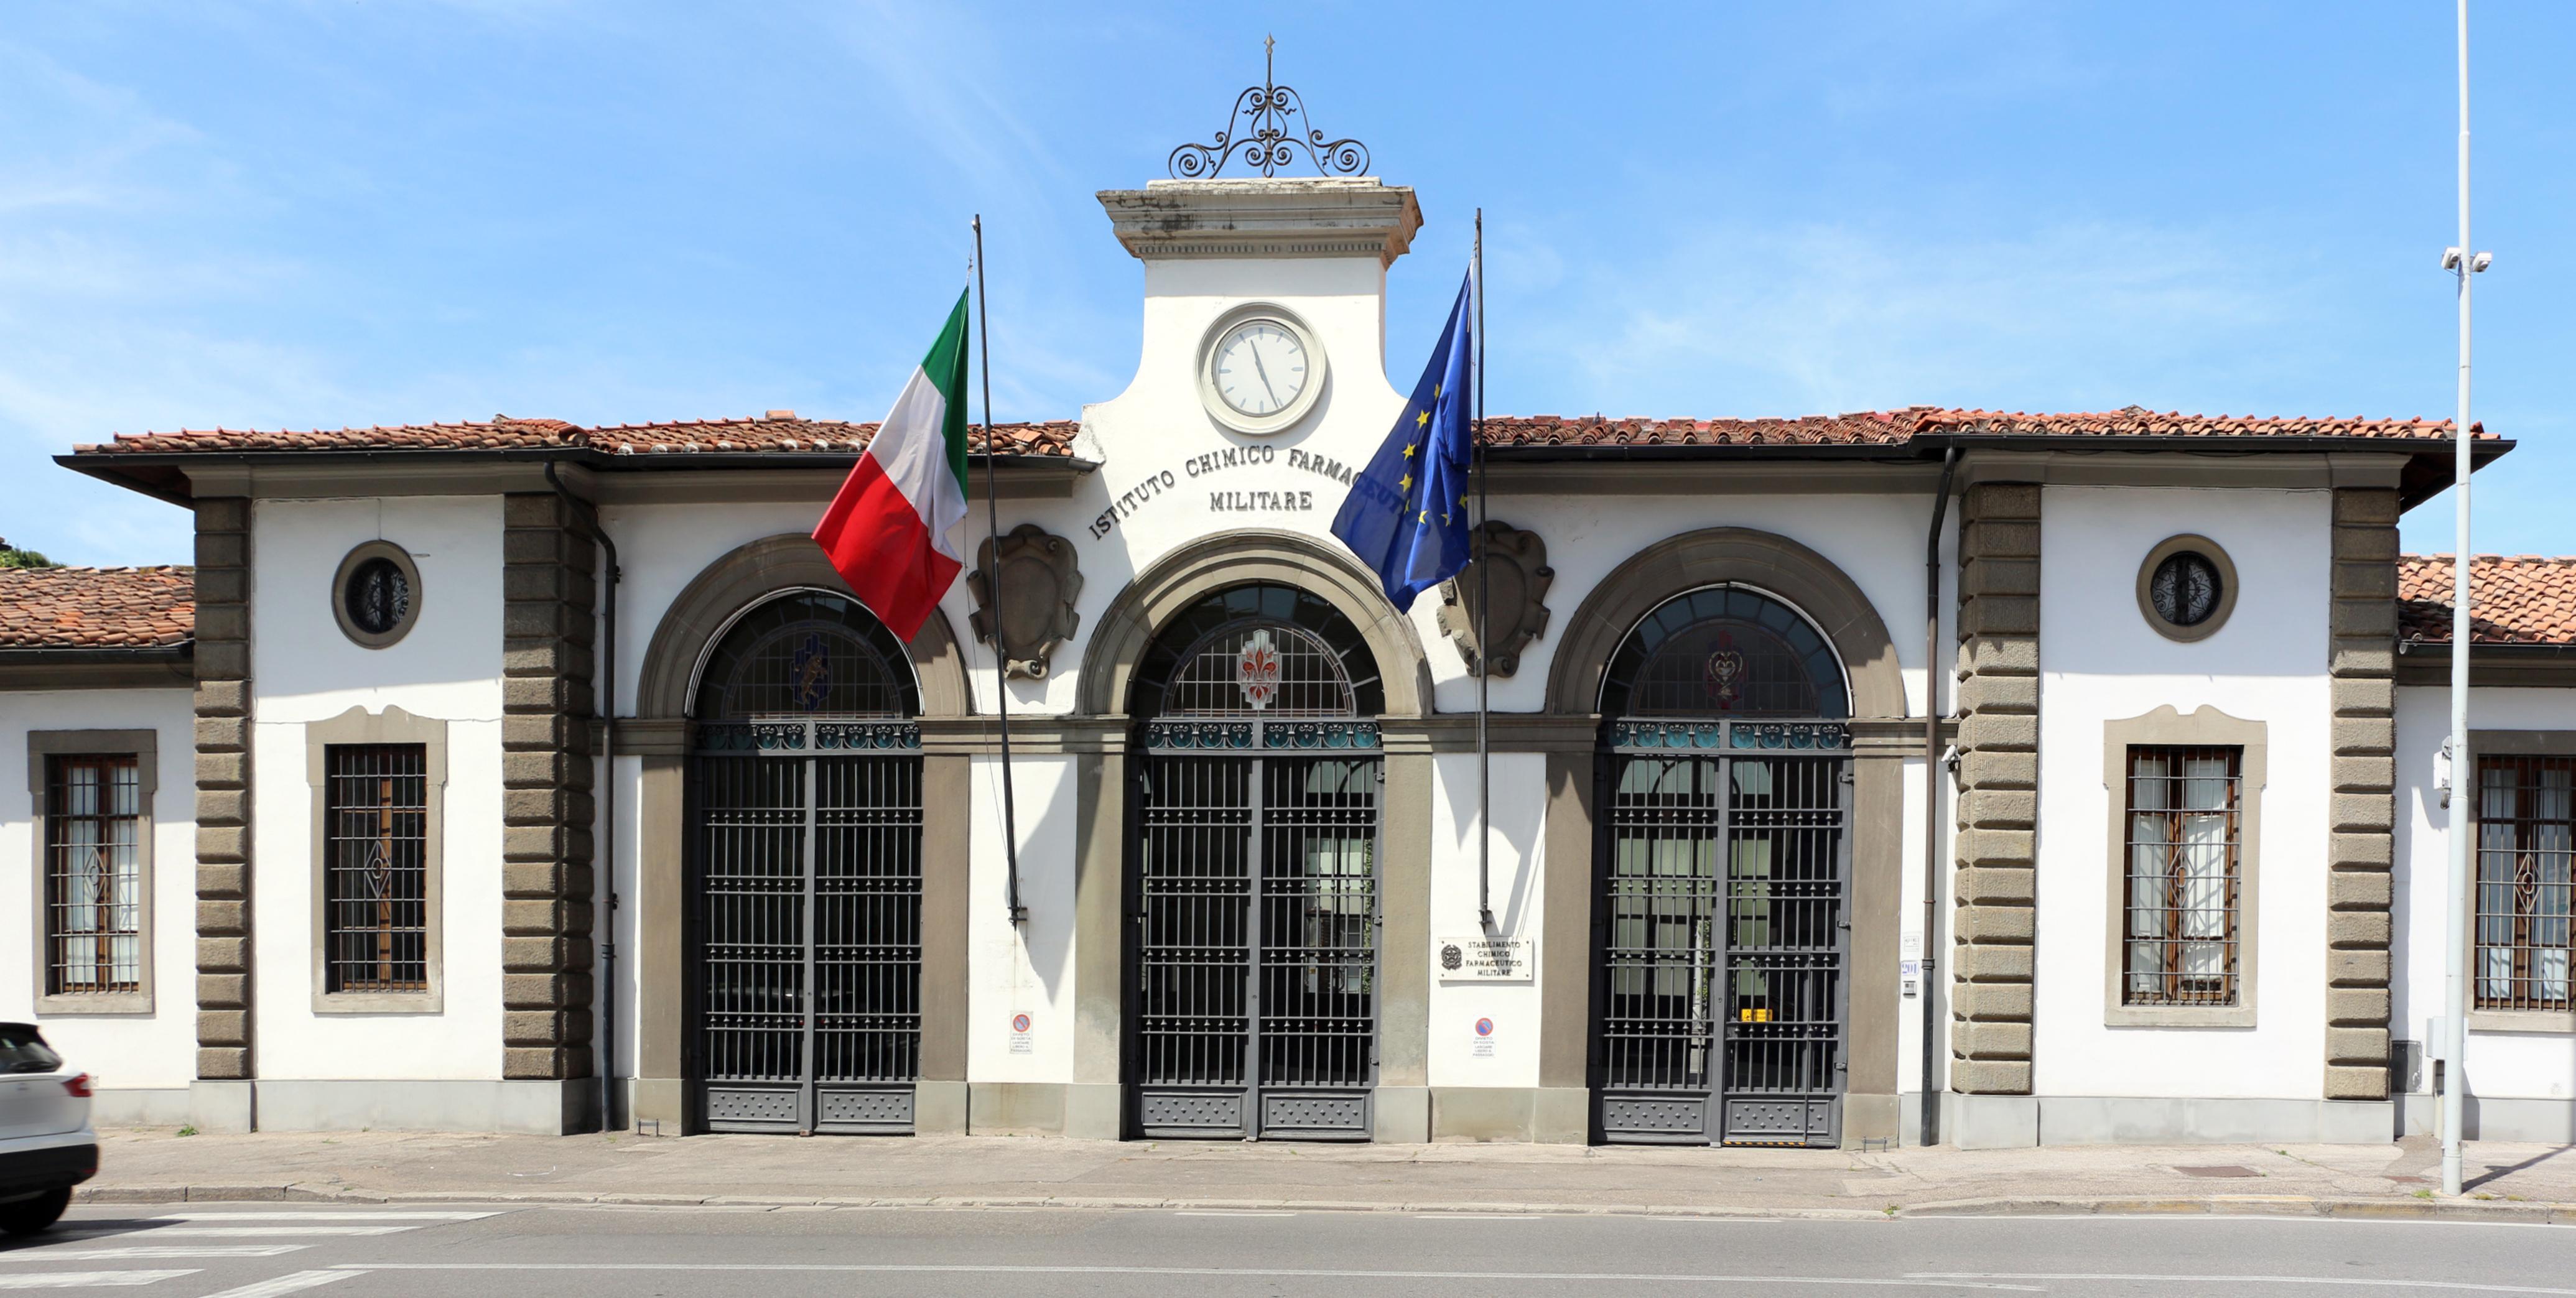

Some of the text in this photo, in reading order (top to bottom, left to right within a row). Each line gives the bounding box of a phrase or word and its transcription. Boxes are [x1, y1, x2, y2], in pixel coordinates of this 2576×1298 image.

[1089, 470, 1175, 540] ISTITUTO
[1186, 445, 1275, 478] CHIMICO
[1210, 491, 1313, 511] MILITARE
